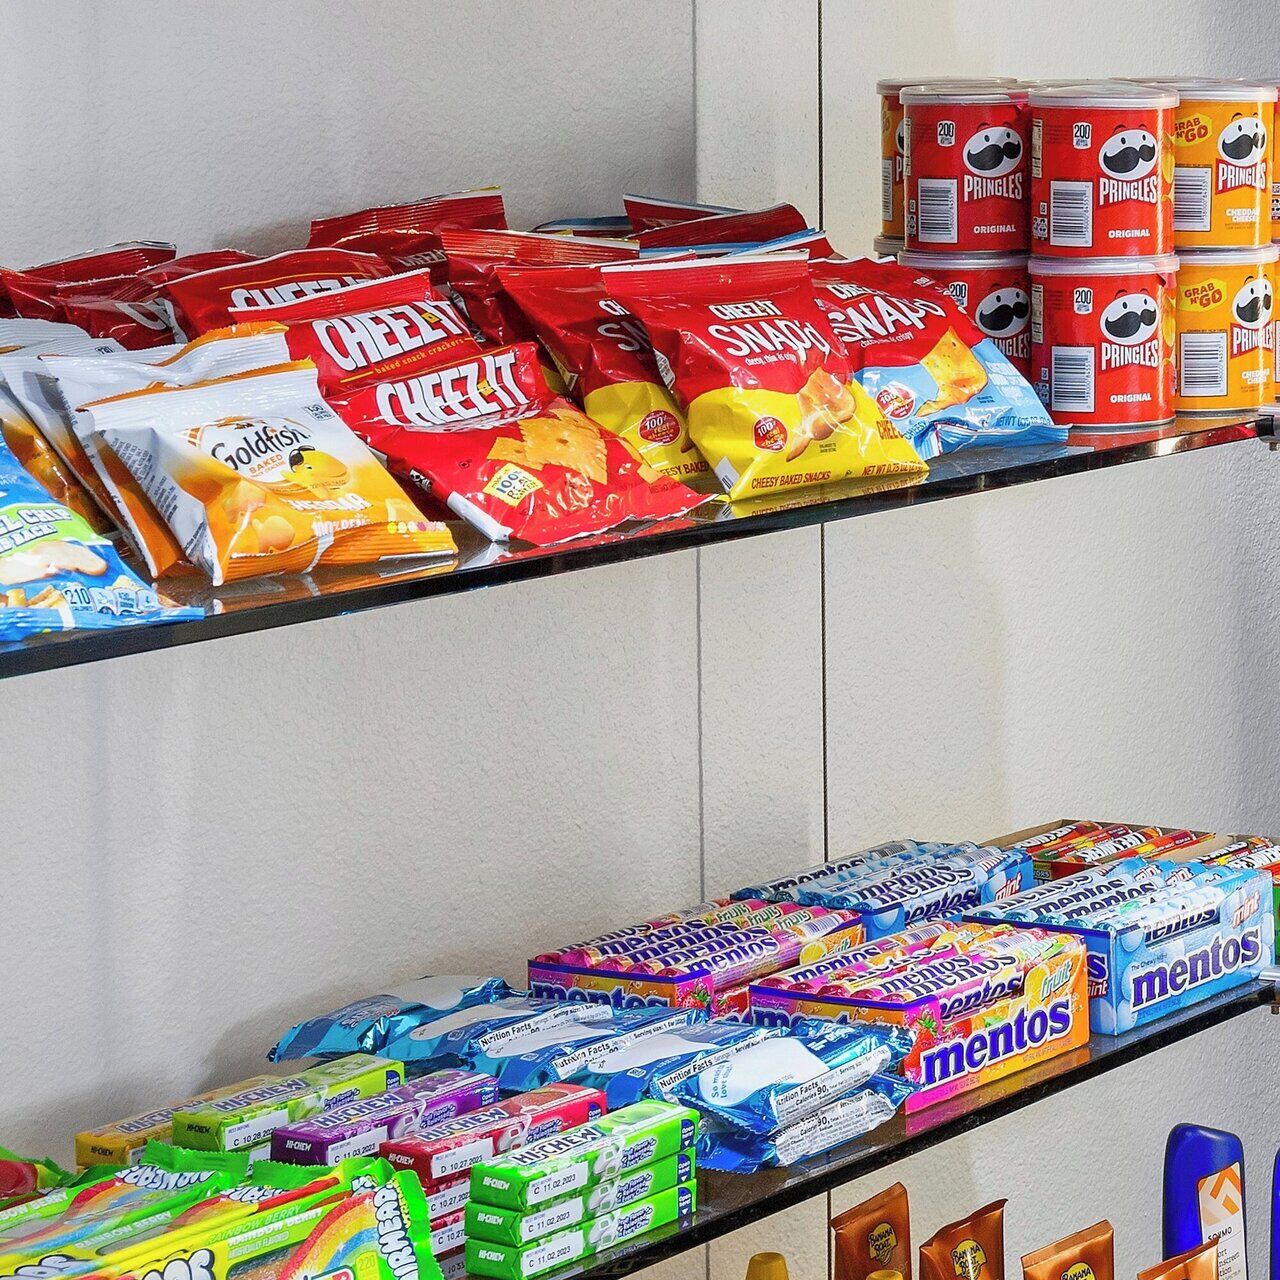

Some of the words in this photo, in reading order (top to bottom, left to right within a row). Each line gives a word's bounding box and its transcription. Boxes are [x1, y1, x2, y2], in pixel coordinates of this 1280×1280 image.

[963, 173, 1023, 202] PRINGLES
[1218, 163, 1266, 190] PRINGLES
[1099, 176, 1158, 206] PRINGLES
[973, 224, 1017, 235] ORIGINAL
[1108, 228, 1151, 240] ORIGINAL
[1185, 283, 1214, 297] GRAB
[375, 358, 402, 375] baked
[403, 348, 428, 366] snack
[429, 336, 465, 357] crackers
[1101, 340, 1158, 371] PRINGLES
[1109, 392, 1152, 403] ORIGINAL
[211, 424, 311, 472] Goldfish
[752, 477, 778, 489] CHEESY
[780, 474, 803, 484] BAKED
[803, 471, 831, 483] SNACKS
[1233, 894, 1261, 927] mint
[1040, 960, 1072, 1001] fruit
[1132, 925, 1262, 1008] mentos
[922, 996, 1073, 1086] mentos
[660, 1068, 691, 1088] Nutrition
[693, 1059, 712, 1071] Facts
[286, 1140, 312, 1151] HI-CHEW
[388, 1153, 415, 1166] HI-CHEW
[510, 1127, 601, 1165] HI-CHEW
[482, 1176, 510, 1190] HI-CHEW
[477, 1213, 504, 1225] HI-CHEW
[478, 1250, 505, 1261] HI-CHEW
